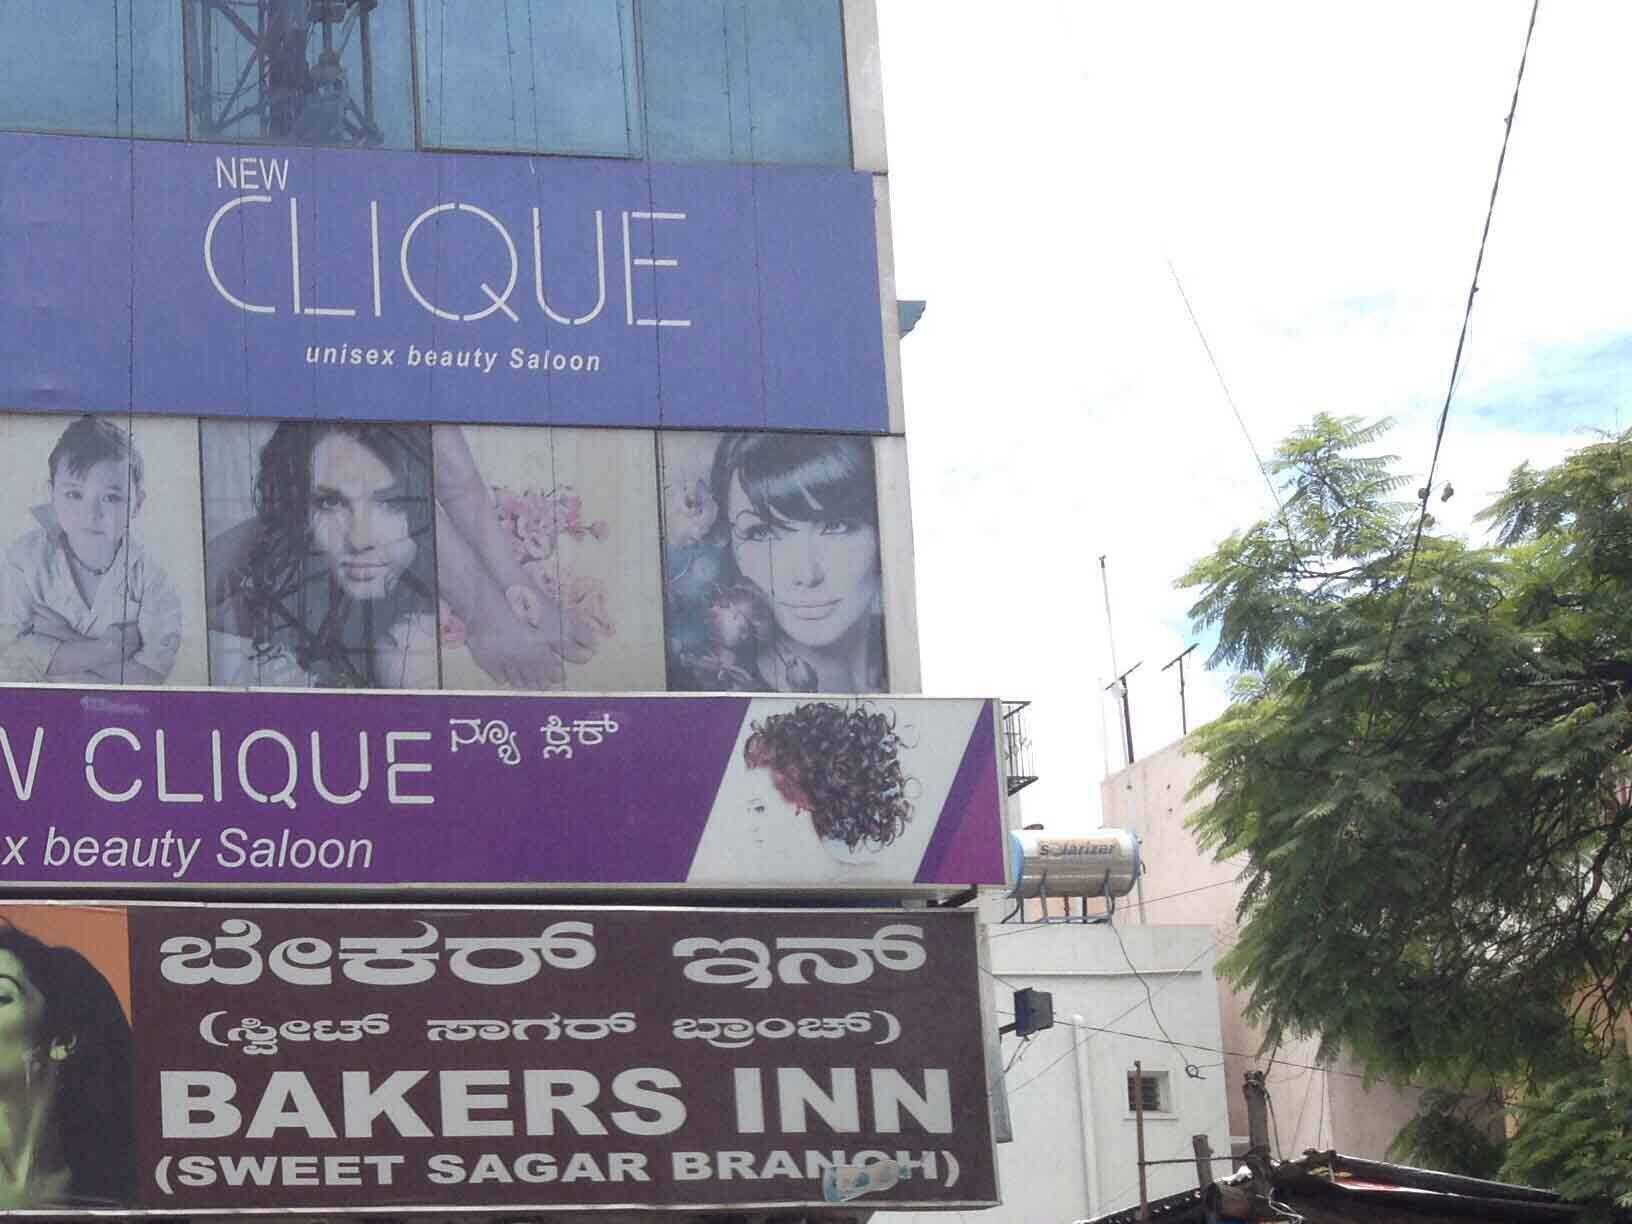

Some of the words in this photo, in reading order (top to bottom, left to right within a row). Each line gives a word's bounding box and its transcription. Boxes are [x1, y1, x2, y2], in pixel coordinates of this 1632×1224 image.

[215, 156, 289, 191] NEW
[204, 194, 692, 327] CLIQUE
[306, 343, 396, 366] unisex
[407, 344, 498, 373] beauty
[510, 347, 601, 371] Saloon
[448, 717, 521, 766] ನ್ಯೂ
[539, 712, 619, 759] ಕ್ಲಿಕ್
[85, 727, 435, 810] CLIQUE
[42, 826, 201, 878] beauty
[216, 827, 374, 869] Saloon
[159, 919, 597, 986] ಬೇಕರ್
[672, 923, 927, 989] ಇನ್
[426, 1012, 637, 1042] ಸಾಗರ್
[159, 1067, 687, 1139] BAKERS
[733, 1067, 953, 1135] INN
[154, 1154, 405, 1195] (SWEET
[445, 1153, 651, 1184] SAGAR
